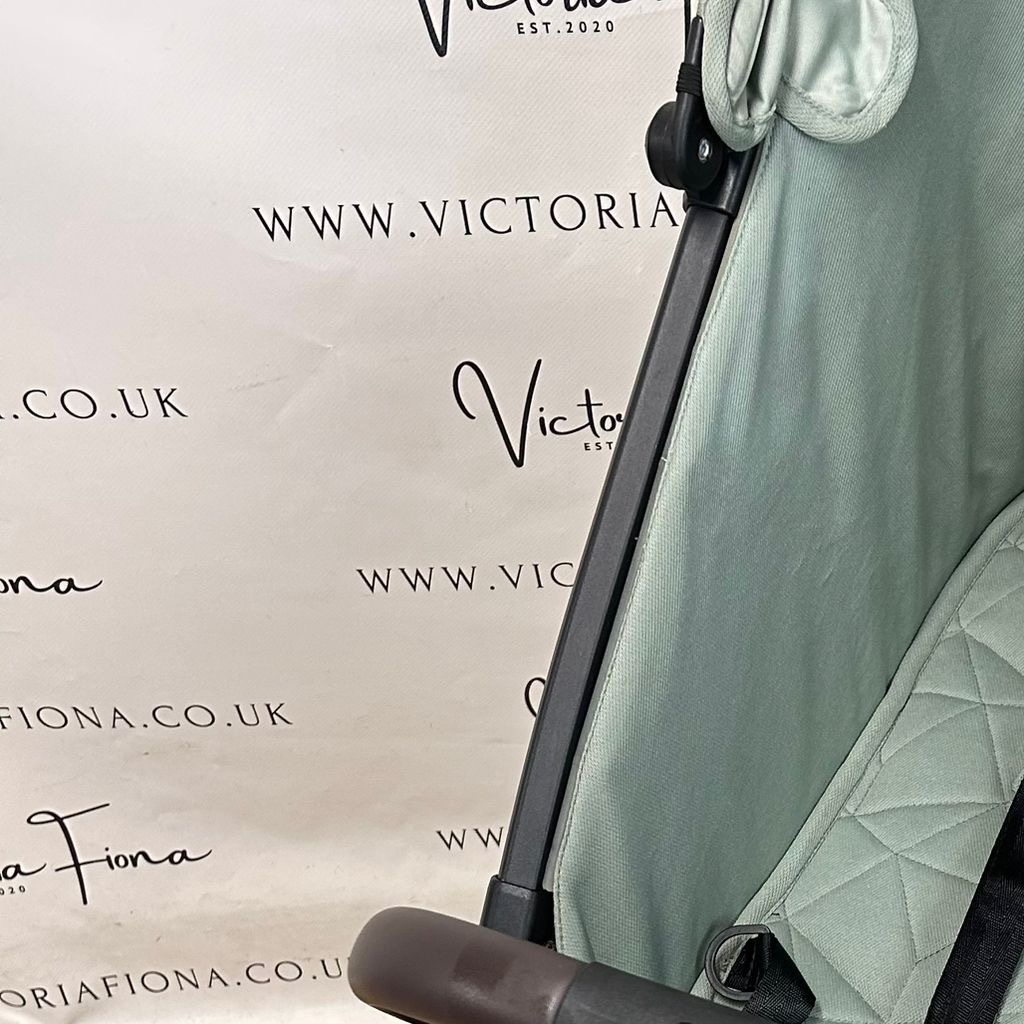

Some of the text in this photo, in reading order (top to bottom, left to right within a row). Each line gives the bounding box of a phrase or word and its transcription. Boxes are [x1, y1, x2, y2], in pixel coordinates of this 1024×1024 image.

[517, 20, 615, 35] EST.2020
[252, 191, 680, 243] WWW.VICTORIA
[0, 388, 189, 420] .CO.UK
[27, 803, 212, 905] Fiona
